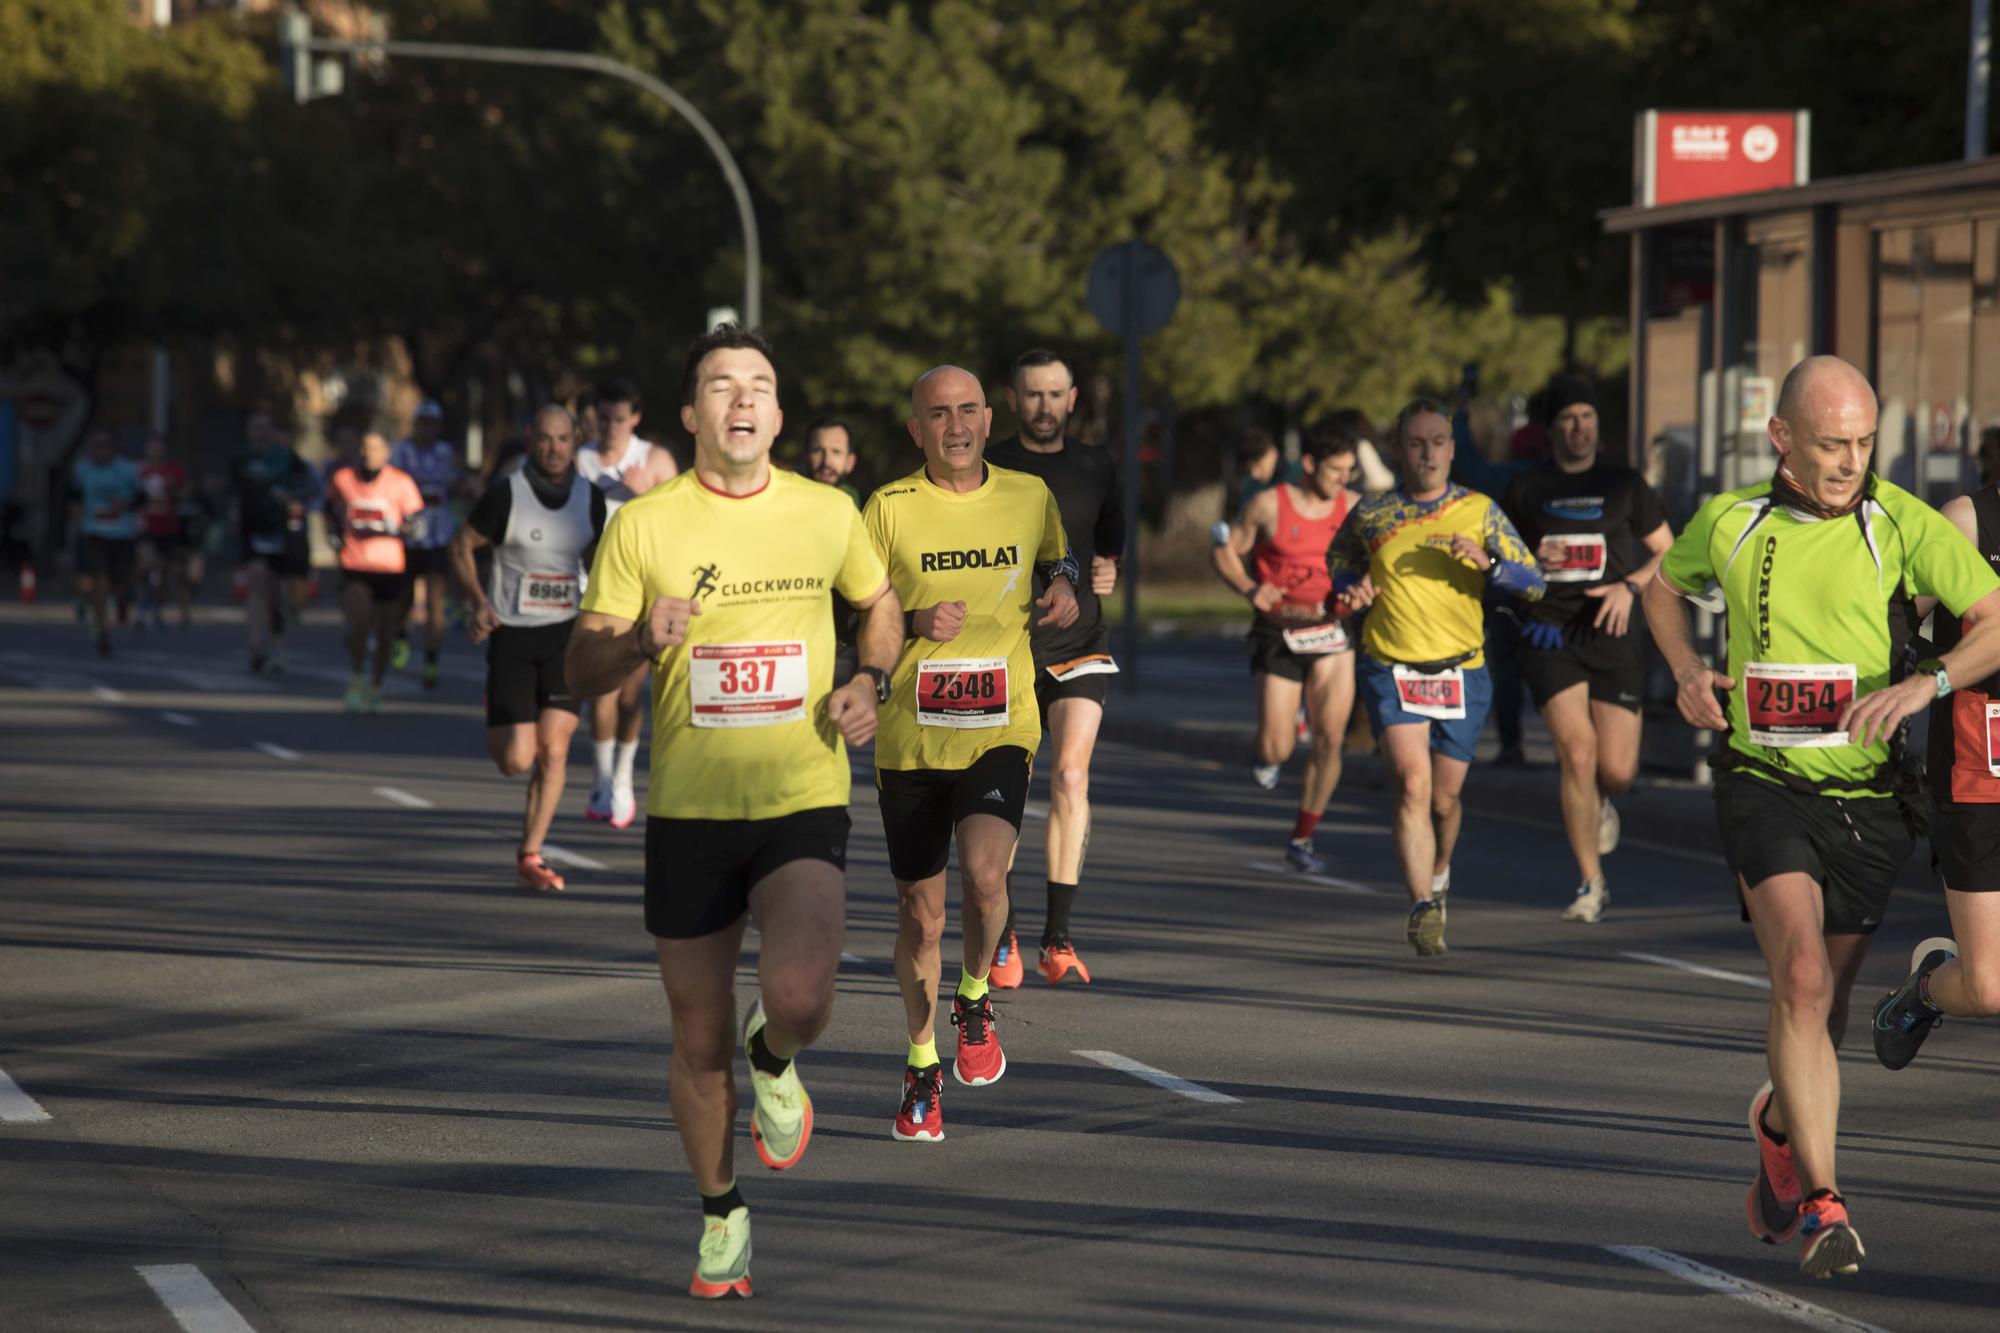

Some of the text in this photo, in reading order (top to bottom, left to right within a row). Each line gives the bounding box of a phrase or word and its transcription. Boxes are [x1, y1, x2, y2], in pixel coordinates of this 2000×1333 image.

[920, 546, 1018, 573] REDOLAT
[721, 577, 825, 597] CLOCKWORK
[719, 660, 776, 694] 337
[931, 672, 995, 700] 2548
[1758, 681, 1838, 714] 2954
